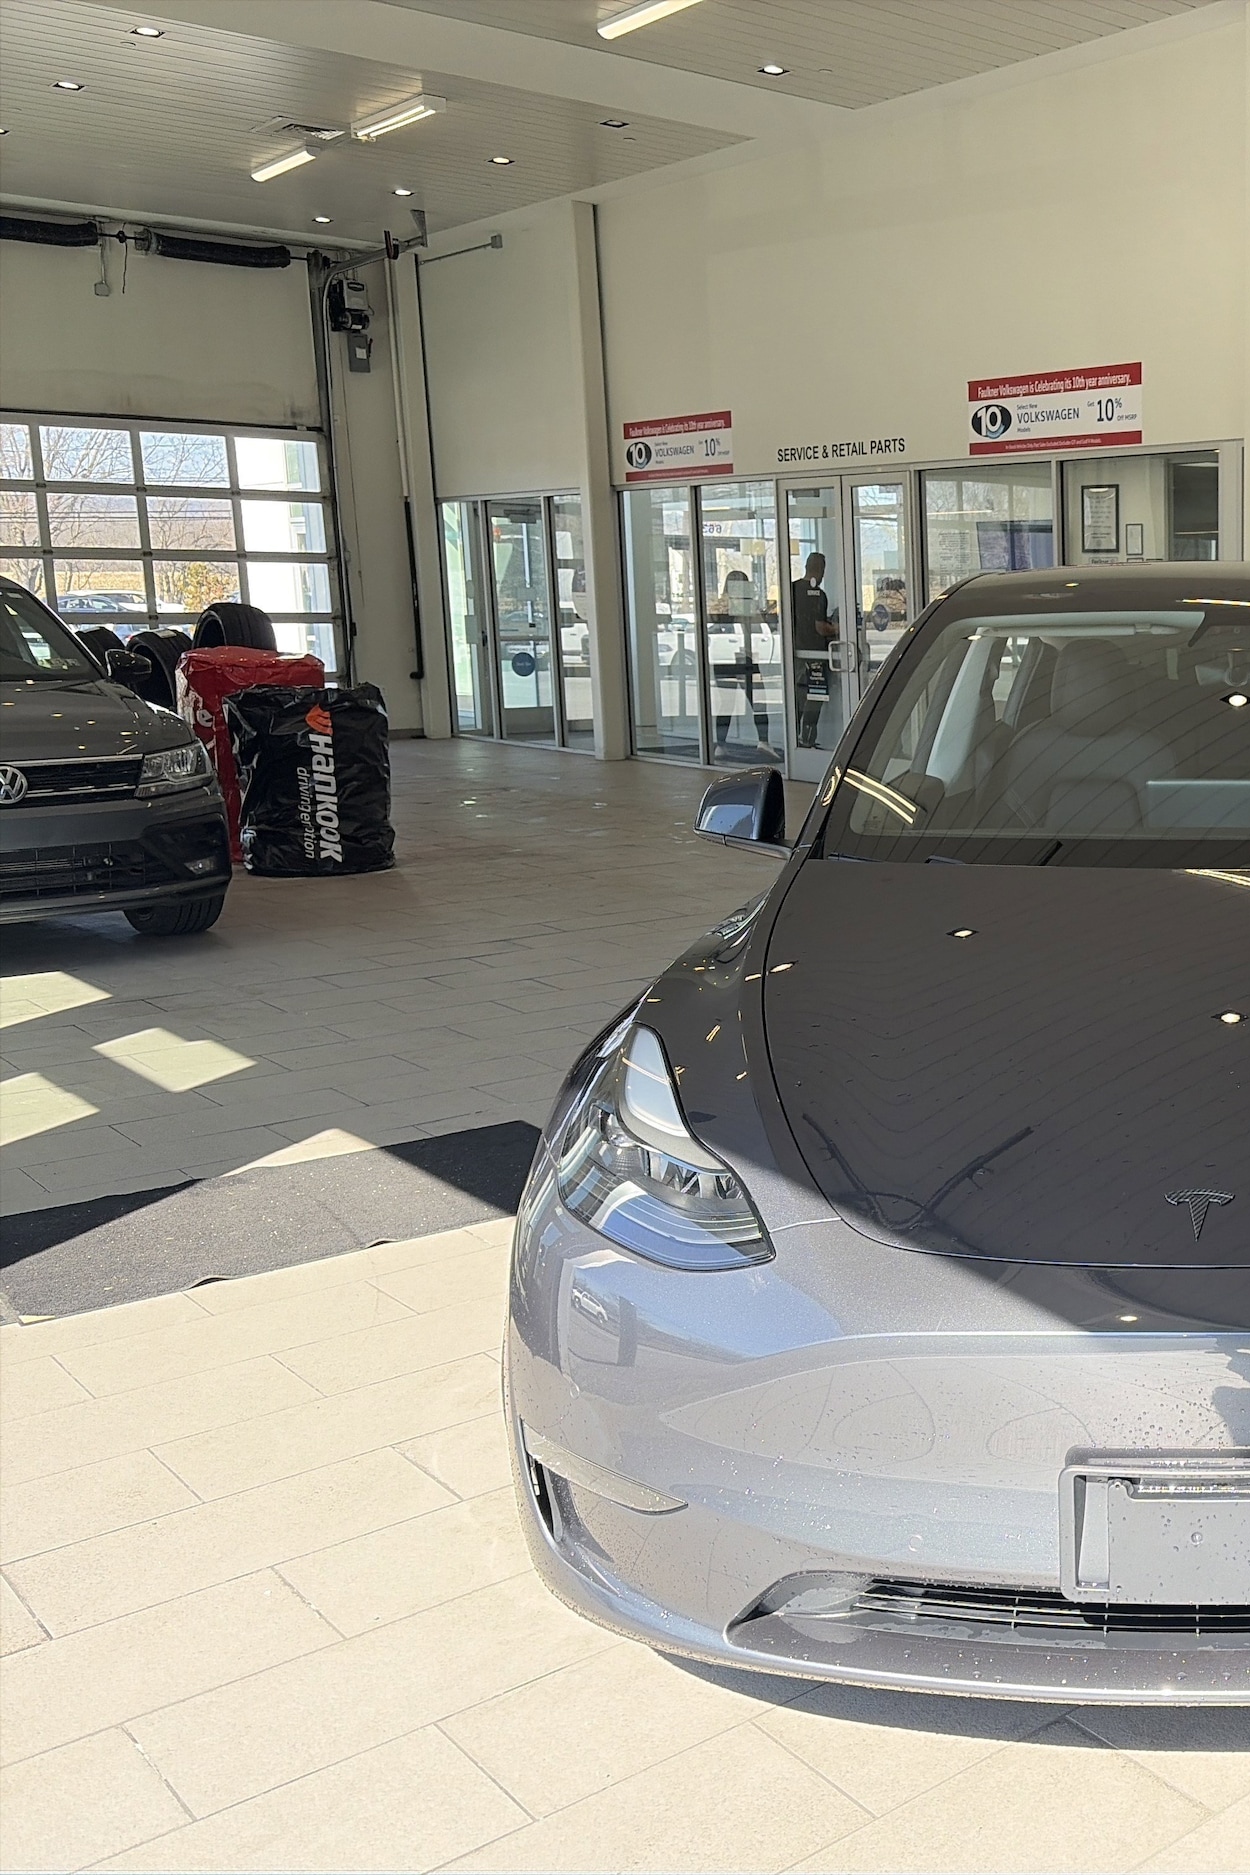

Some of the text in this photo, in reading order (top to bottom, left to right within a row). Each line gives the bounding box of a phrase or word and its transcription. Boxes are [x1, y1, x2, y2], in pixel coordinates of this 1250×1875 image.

[999, 383, 1029, 397] Volkswagen
[1035, 378, 1064, 393] Celebrating
[1016, 407, 1080, 424] VOLKSWAGEN
[655, 445, 694, 457] VOLKSWAGEN
[777, 437, 905, 462] SERVICE & RETAIL PARTS
